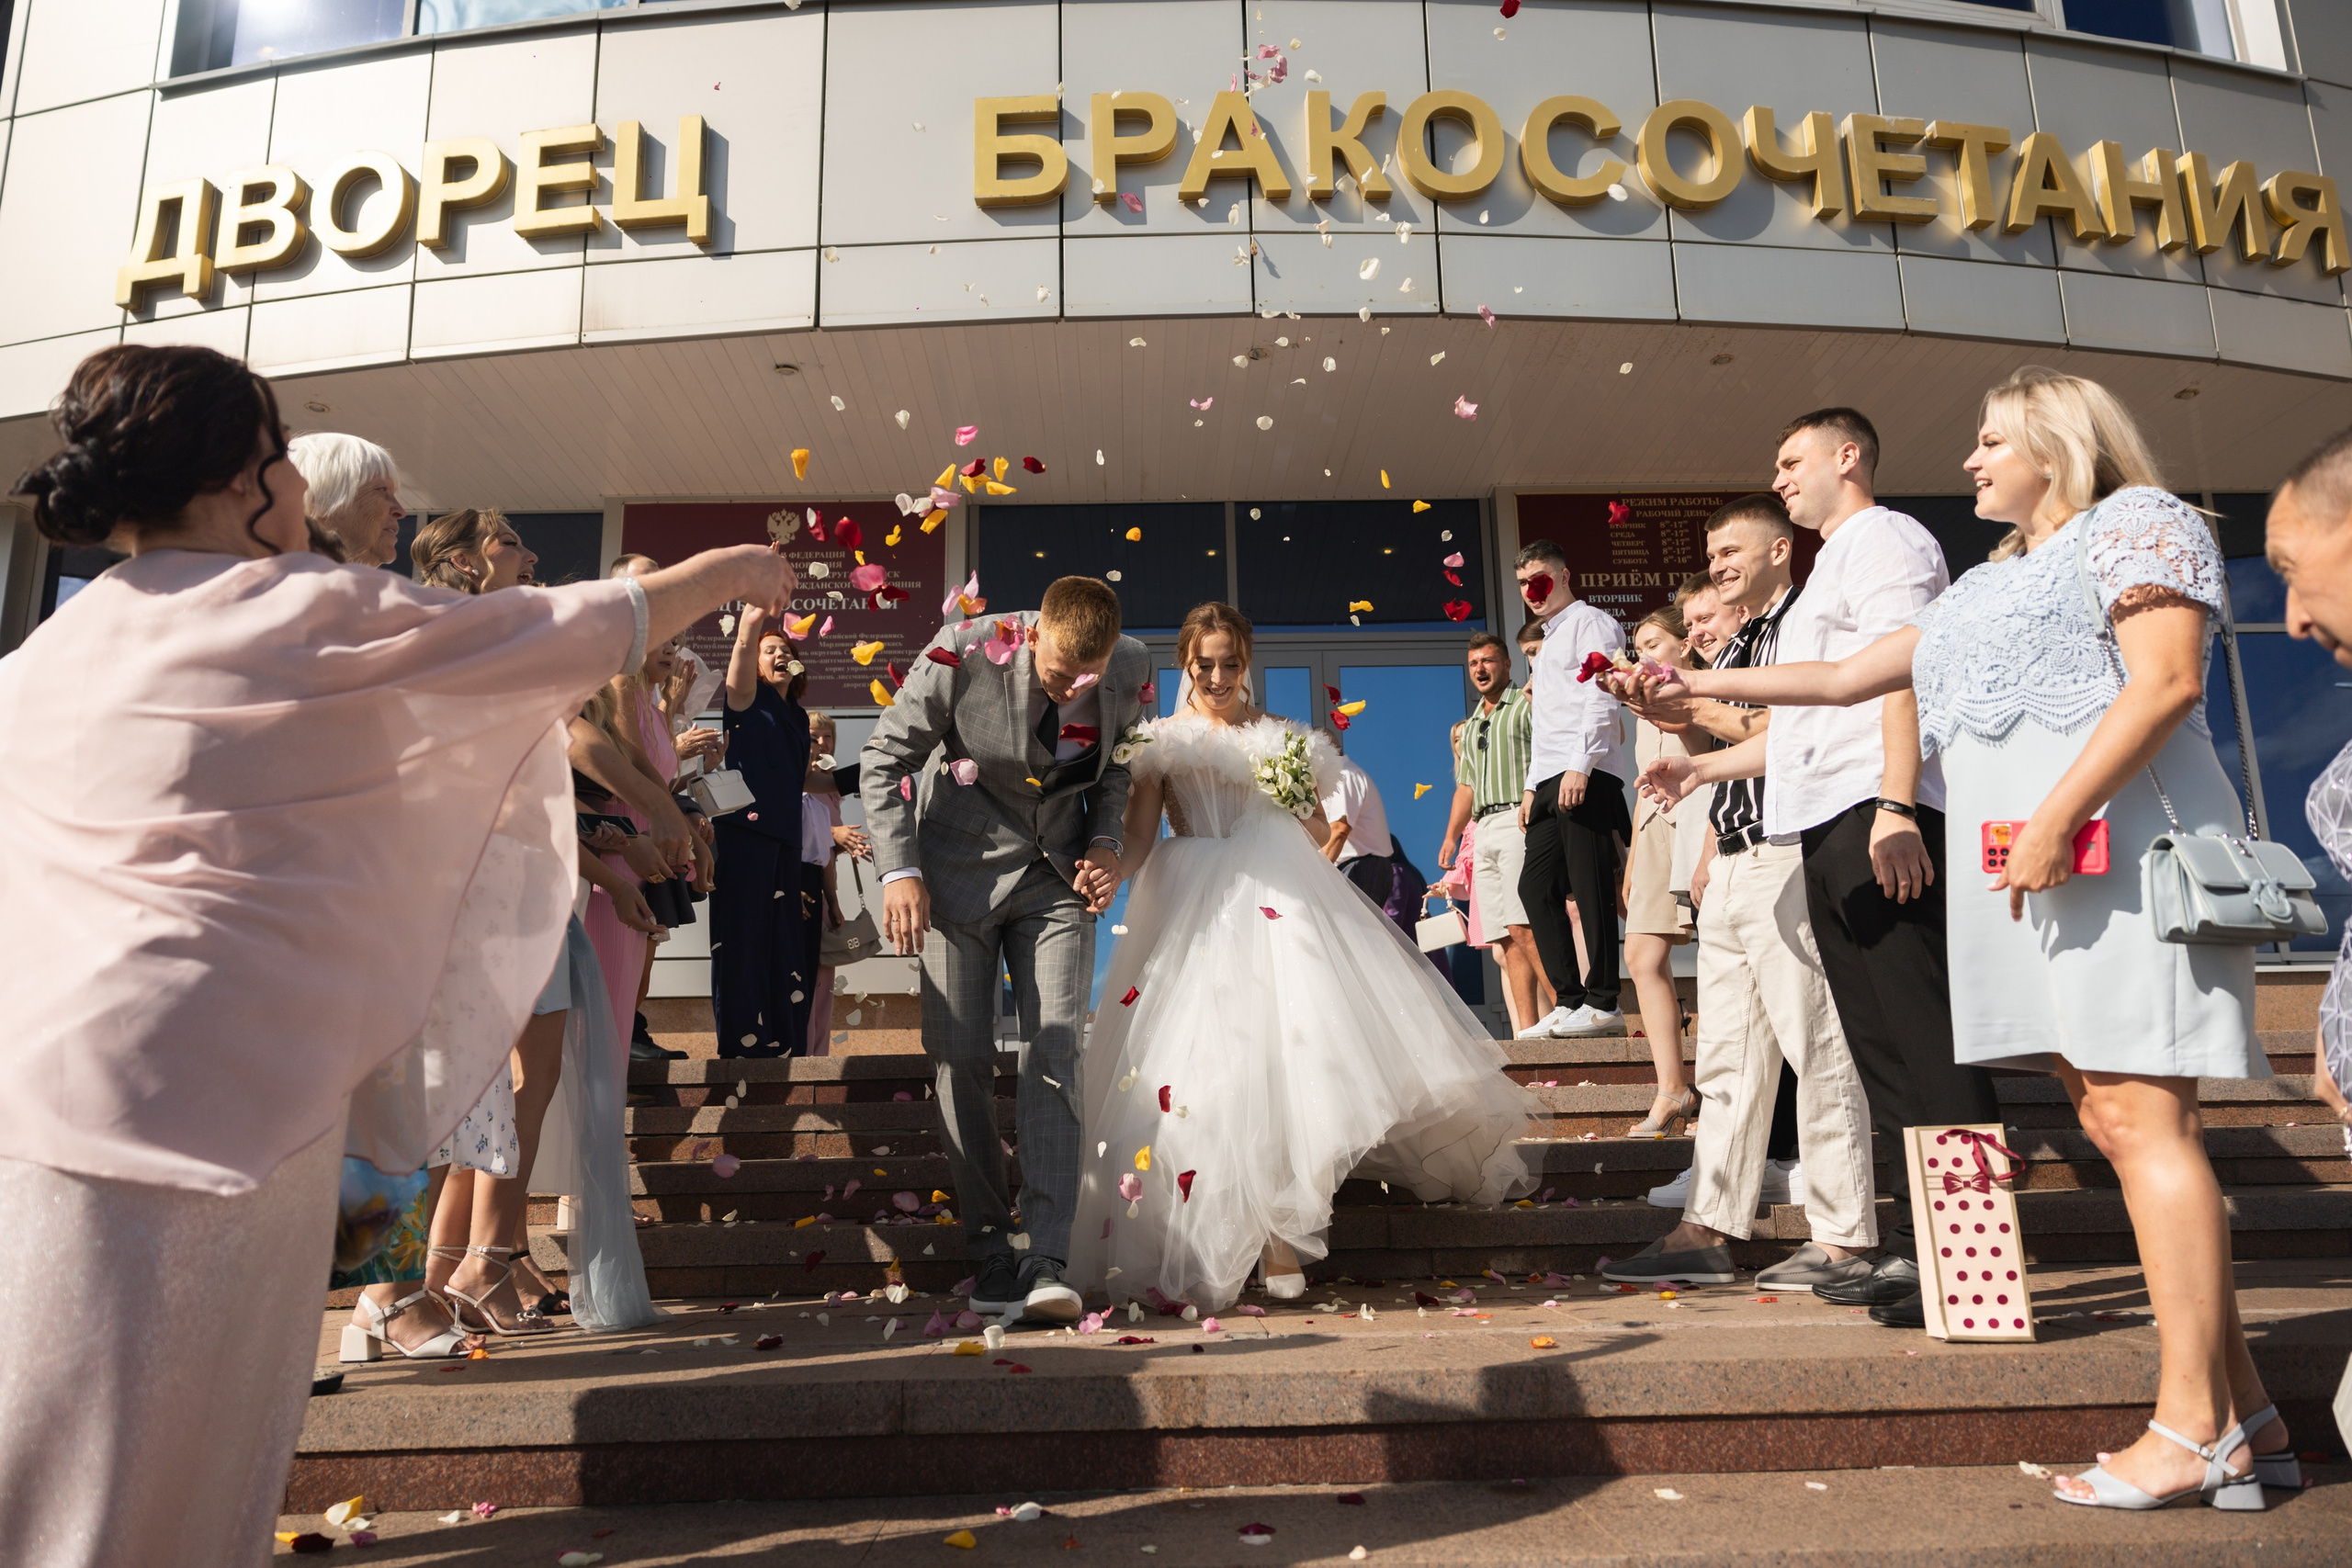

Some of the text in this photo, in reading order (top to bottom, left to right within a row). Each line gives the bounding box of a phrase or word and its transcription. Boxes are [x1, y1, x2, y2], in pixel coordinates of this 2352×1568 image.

[115, 89, 2351, 310] ДВОРЕЦ БРАКОСОЧЕТАНИЯ
[1622, 497, 1724, 506] РЕЖИМ РАБОТЫ:
[1636, 509, 1681, 517] РАБОЧИЙ
[788, 551, 845, 559] ФЕДЕРАЦИЯ
[1579, 569, 1661, 587] ПРИЁМ
[1589, 594, 1643, 604] ВТОРНИК
[1601, 608, 1626, 617] ЕДА
